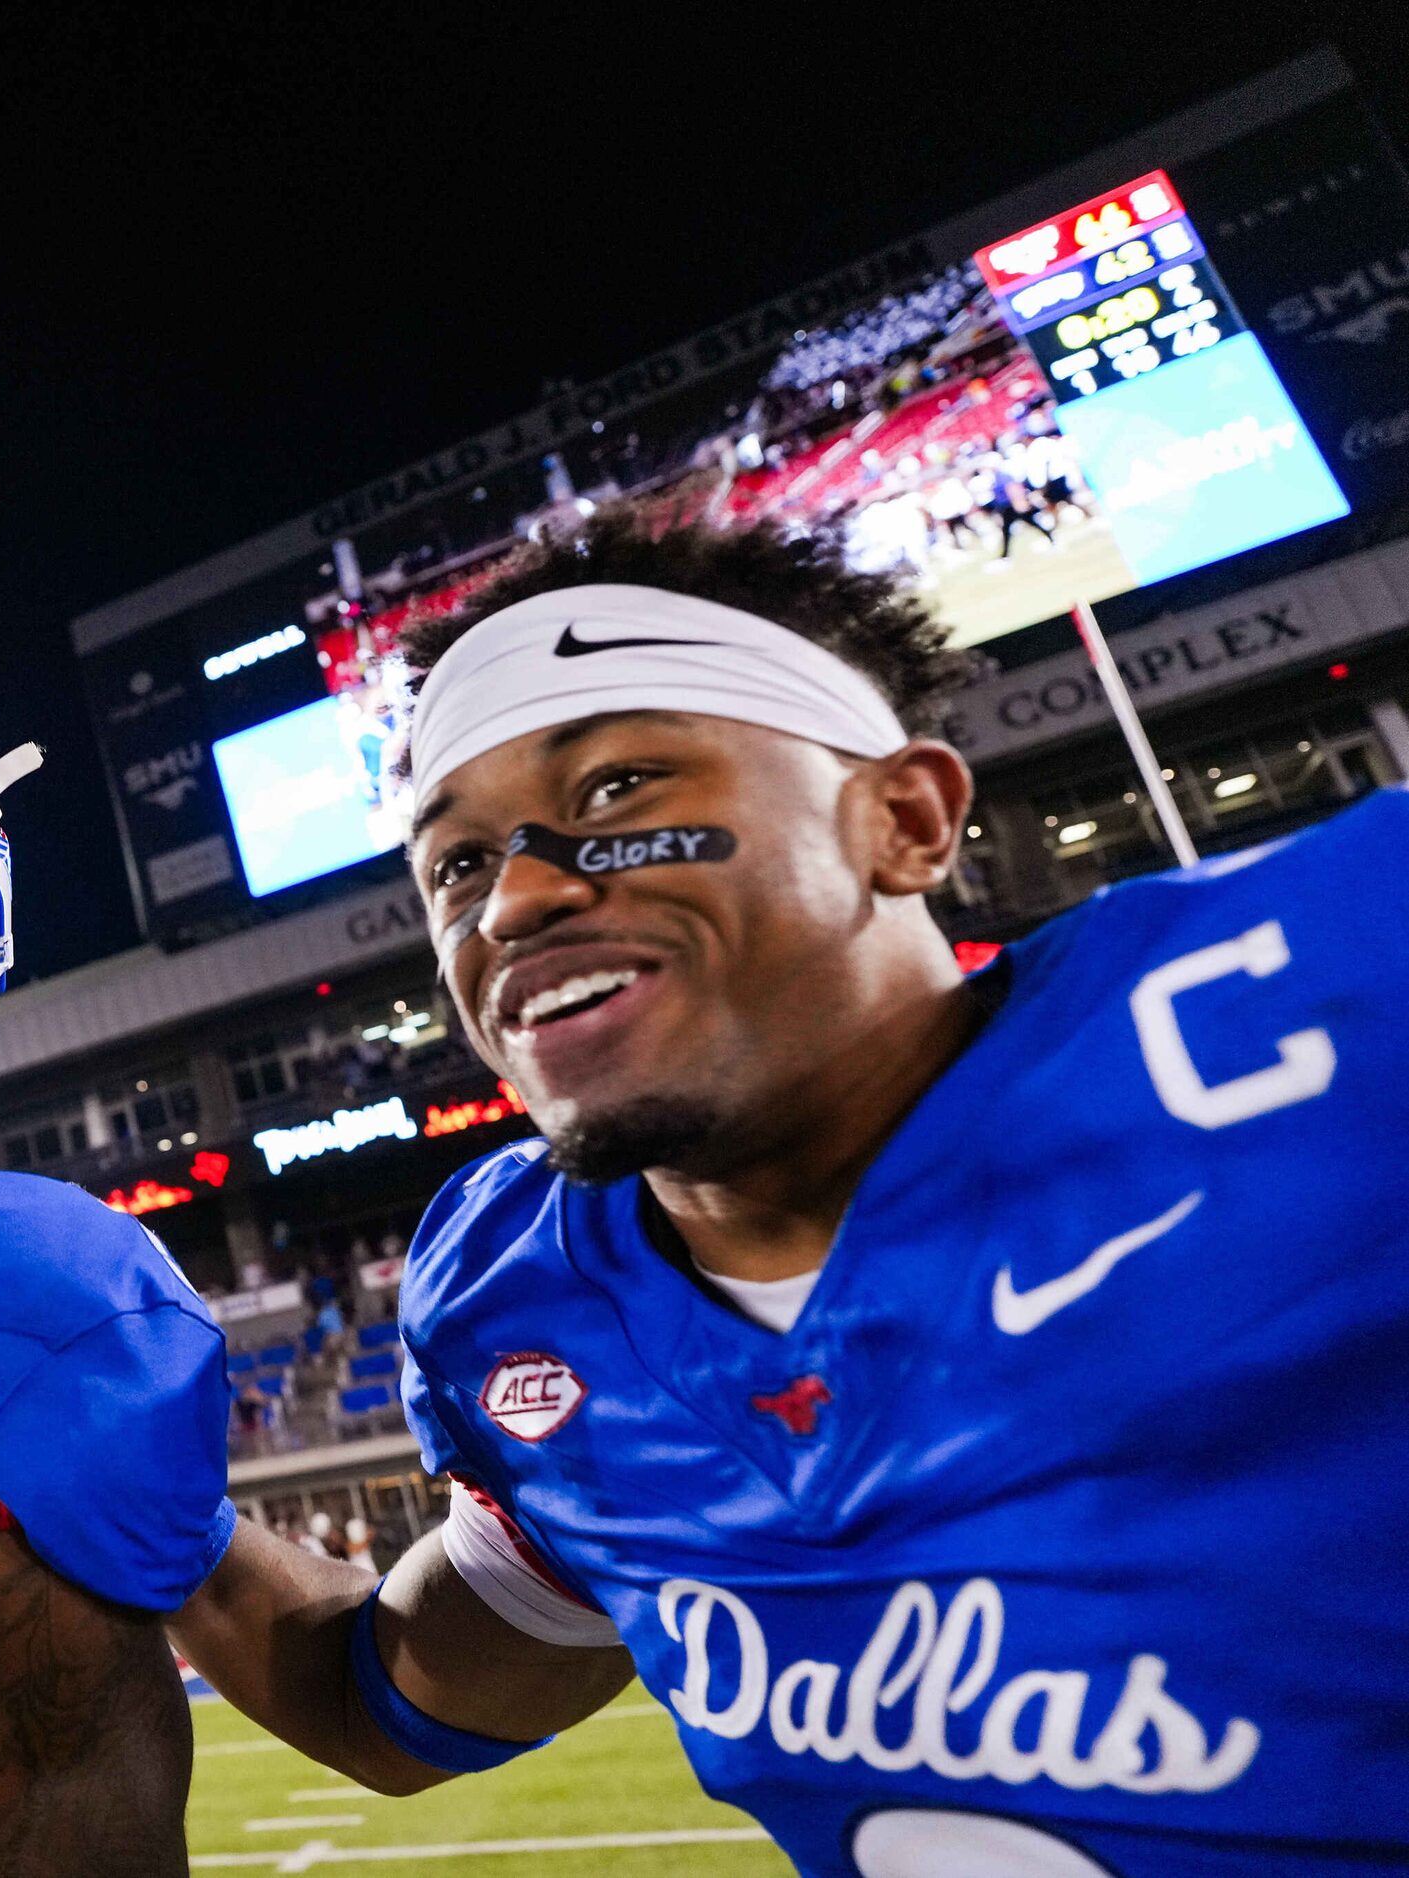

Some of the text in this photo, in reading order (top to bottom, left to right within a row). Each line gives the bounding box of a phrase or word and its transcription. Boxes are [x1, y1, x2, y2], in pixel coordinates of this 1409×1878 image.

[1095, 240, 1155, 285] 42
[1267, 248, 1409, 334] SMU
[311, 443, 488, 538] GERALD
[550, 354, 683, 433] FORD
[695, 237, 934, 369] STADIUM
[998, 605, 1306, 728] COMPLEX
[123, 739, 204, 796] SMU
[576, 829, 707, 873] GLORY
[1129, 919, 1338, 1131] C
[498, 1370, 564, 1407] ACC
[658, 1577, 1261, 1794] Dallas
